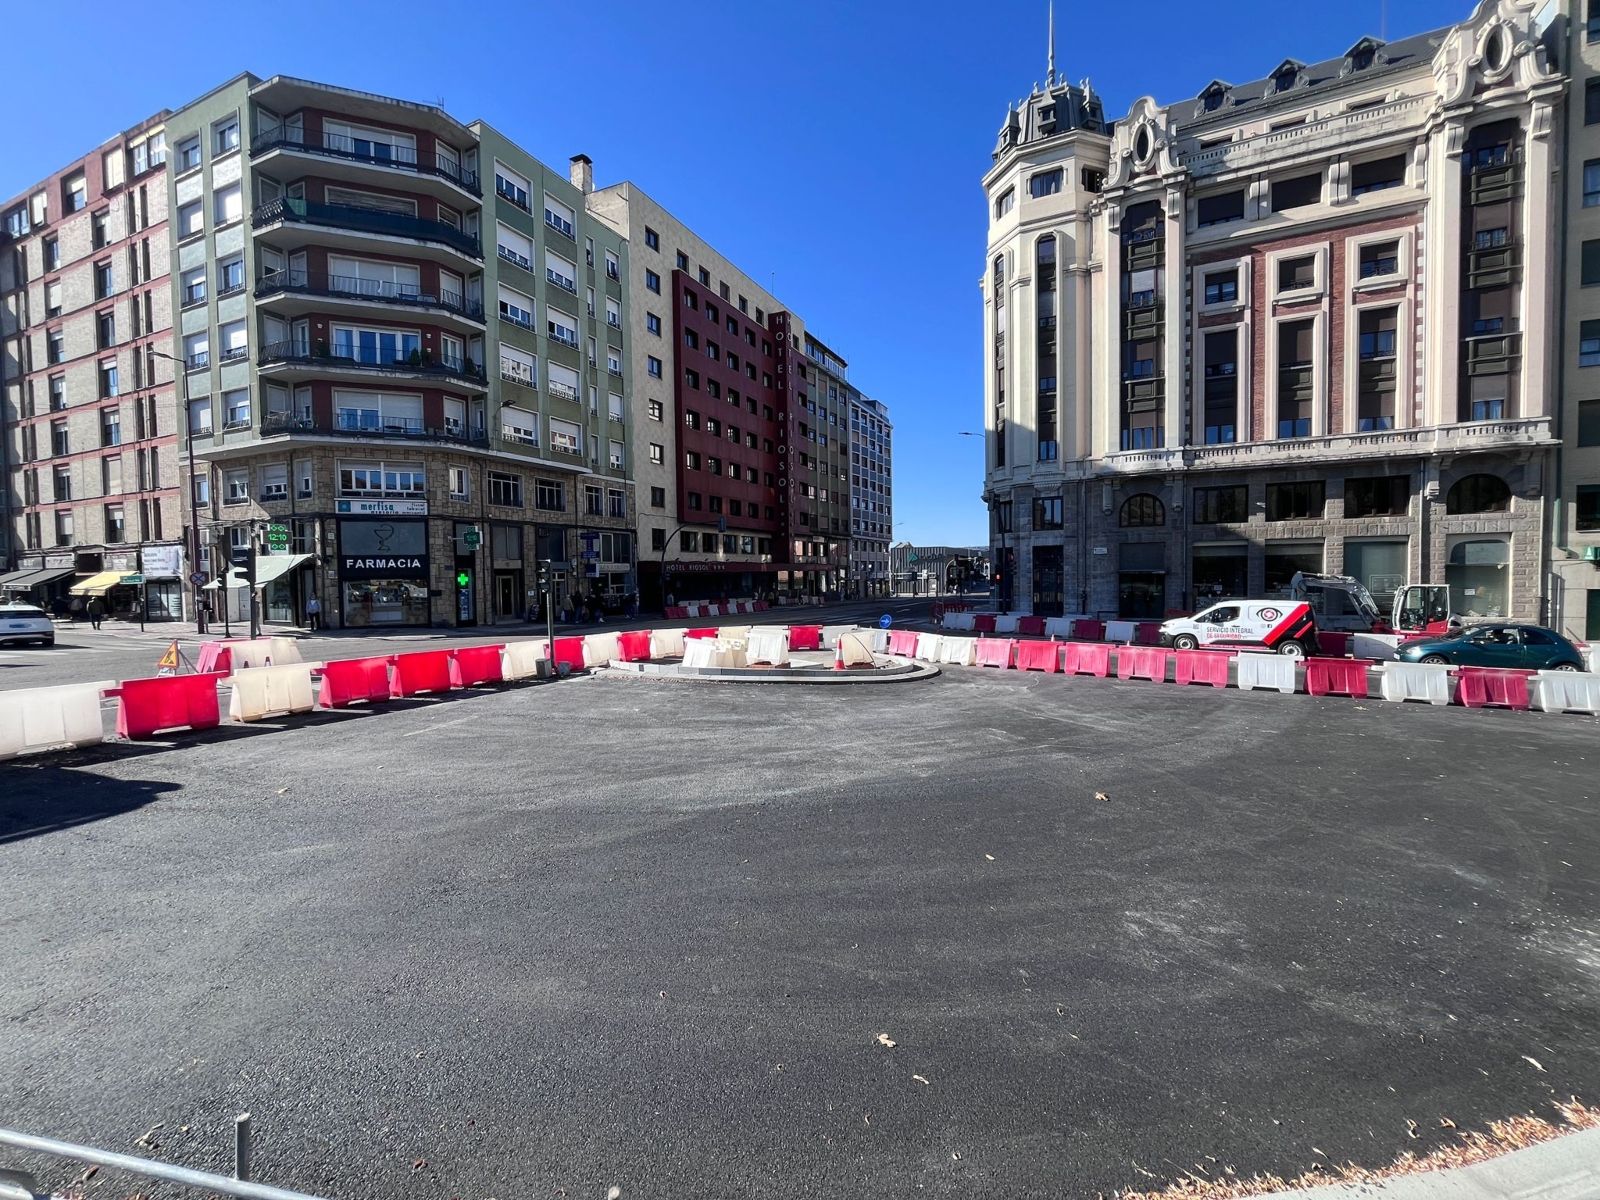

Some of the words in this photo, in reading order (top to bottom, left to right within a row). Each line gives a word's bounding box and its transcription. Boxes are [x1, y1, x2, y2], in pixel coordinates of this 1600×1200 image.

[775, 314, 784, 390] HOTEL
[776, 411, 787, 504] RIOSOL
[268, 533, 287, 541] 12:10
[346, 558, 421, 569] FARMACIA
